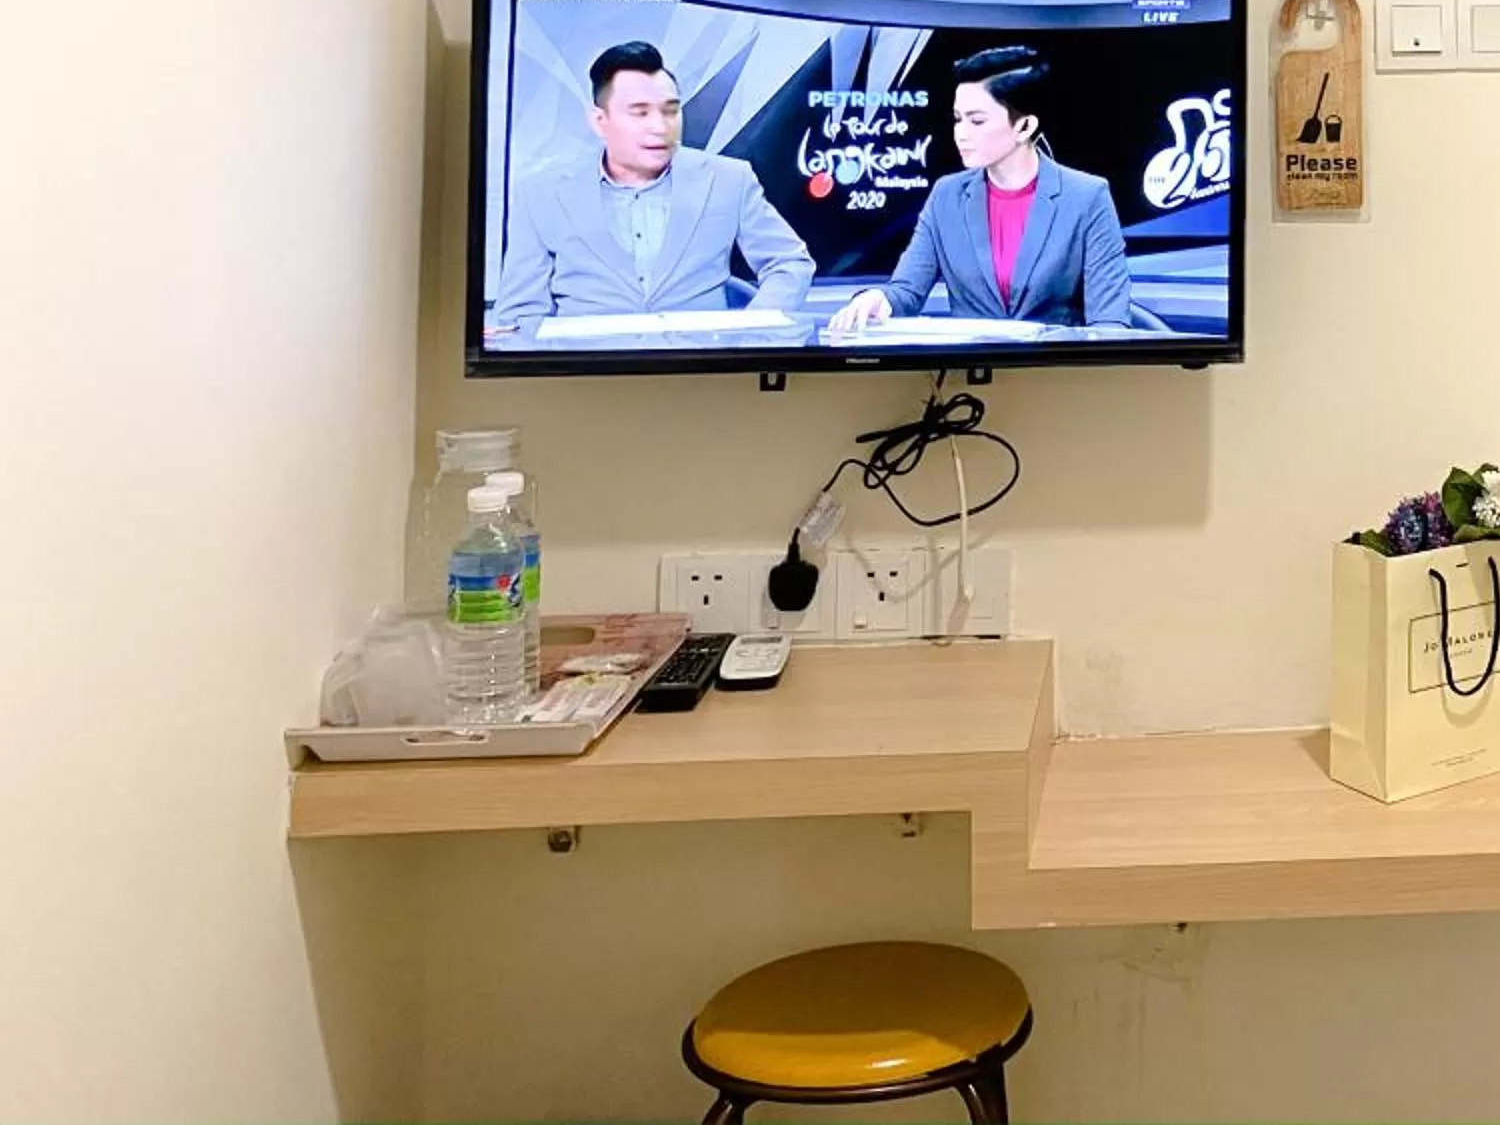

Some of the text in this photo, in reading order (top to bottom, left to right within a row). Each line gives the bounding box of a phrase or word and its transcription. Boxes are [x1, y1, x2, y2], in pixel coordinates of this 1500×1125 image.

[1143, 12, 1179, 23] LIVE
[808, 90, 929, 107] PETRONAS
[884, 109, 908, 136] de
[1286, 154, 1357, 171] Please
[874, 175, 929, 190] Malaysia
[846, 190, 887, 210] 2020
